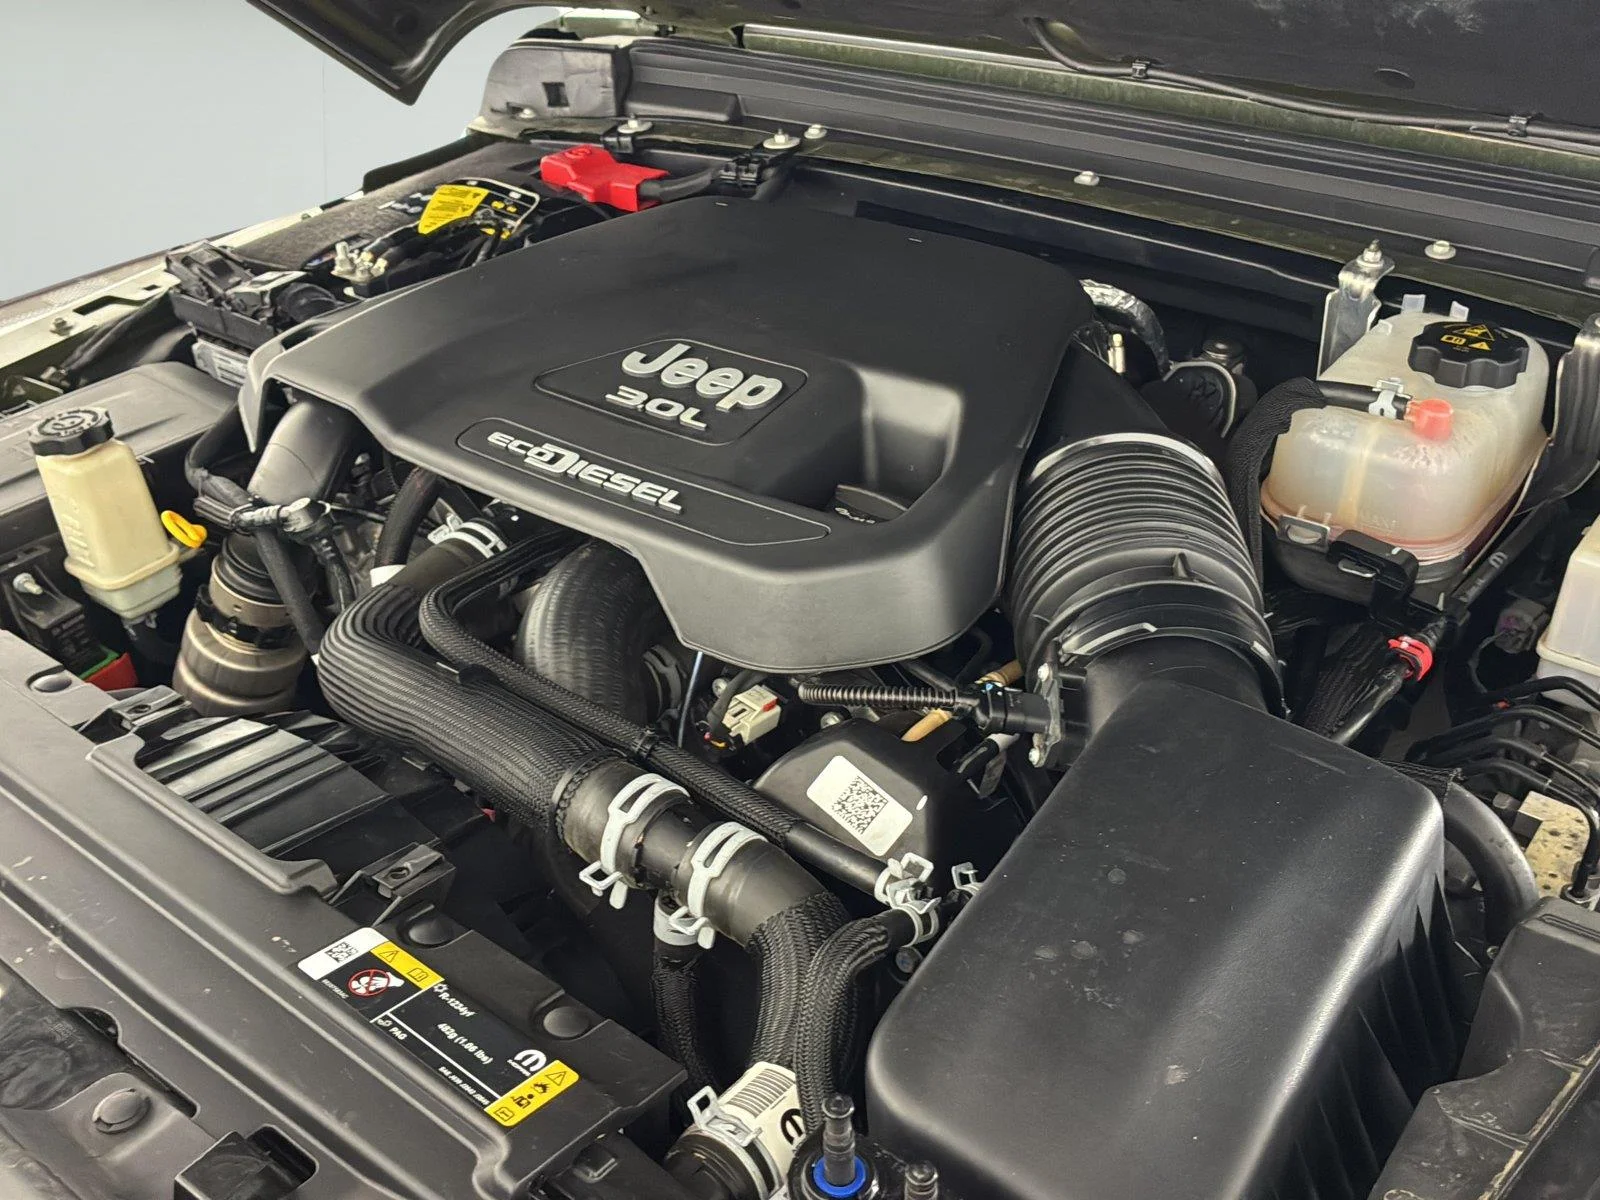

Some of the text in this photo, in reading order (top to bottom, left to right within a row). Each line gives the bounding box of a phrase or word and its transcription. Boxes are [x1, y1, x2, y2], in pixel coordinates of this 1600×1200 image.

[622, 343, 783, 412] Jeep
[605, 385, 708, 431] 3.0L
[438, 992, 477, 1017] R-1234yf
[389, 1026, 408, 1040] PAG
[474, 1049, 494, 1065] lbs)
